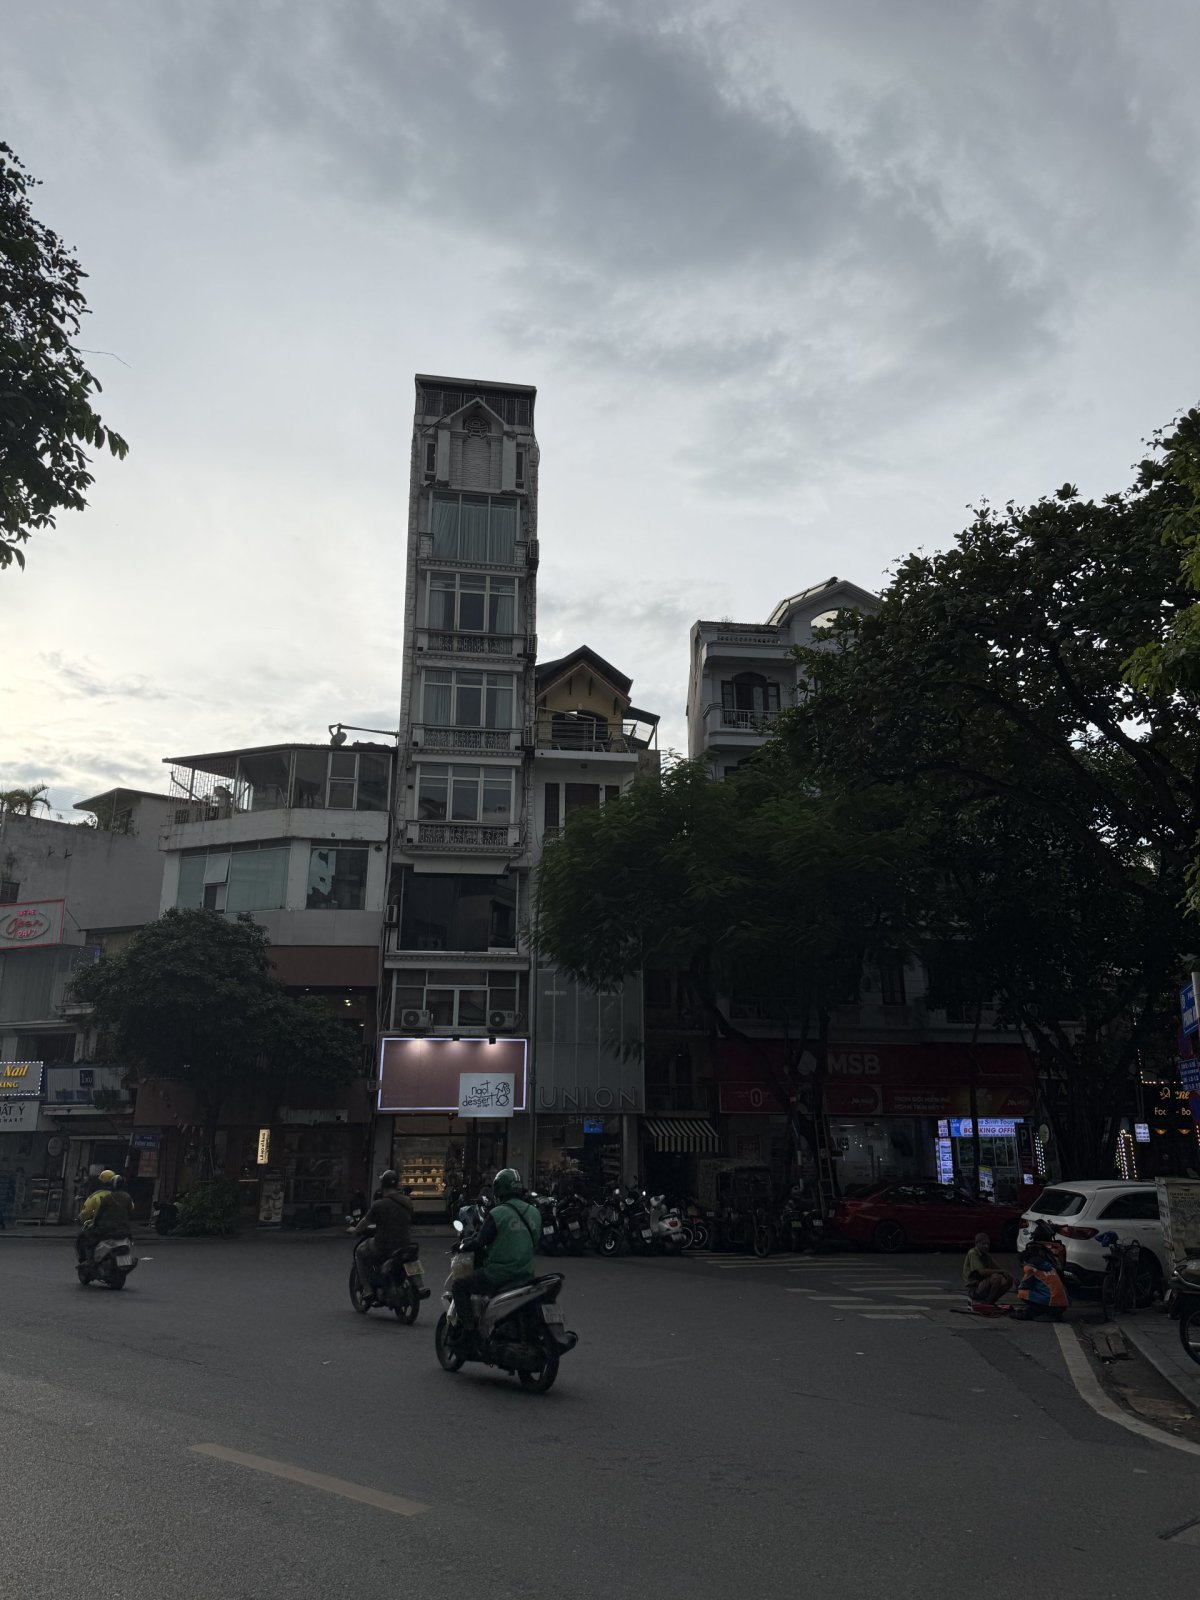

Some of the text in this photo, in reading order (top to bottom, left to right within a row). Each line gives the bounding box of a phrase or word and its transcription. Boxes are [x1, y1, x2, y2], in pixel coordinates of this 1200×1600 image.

[4, 1064, 29, 1078] Nail
[827, 1053, 881, 1075] MSB
[462, 1092, 496, 1107] dessert
[540, 1086, 636, 1109] UNION
[0, 1103, 15, 1117] ẬT
